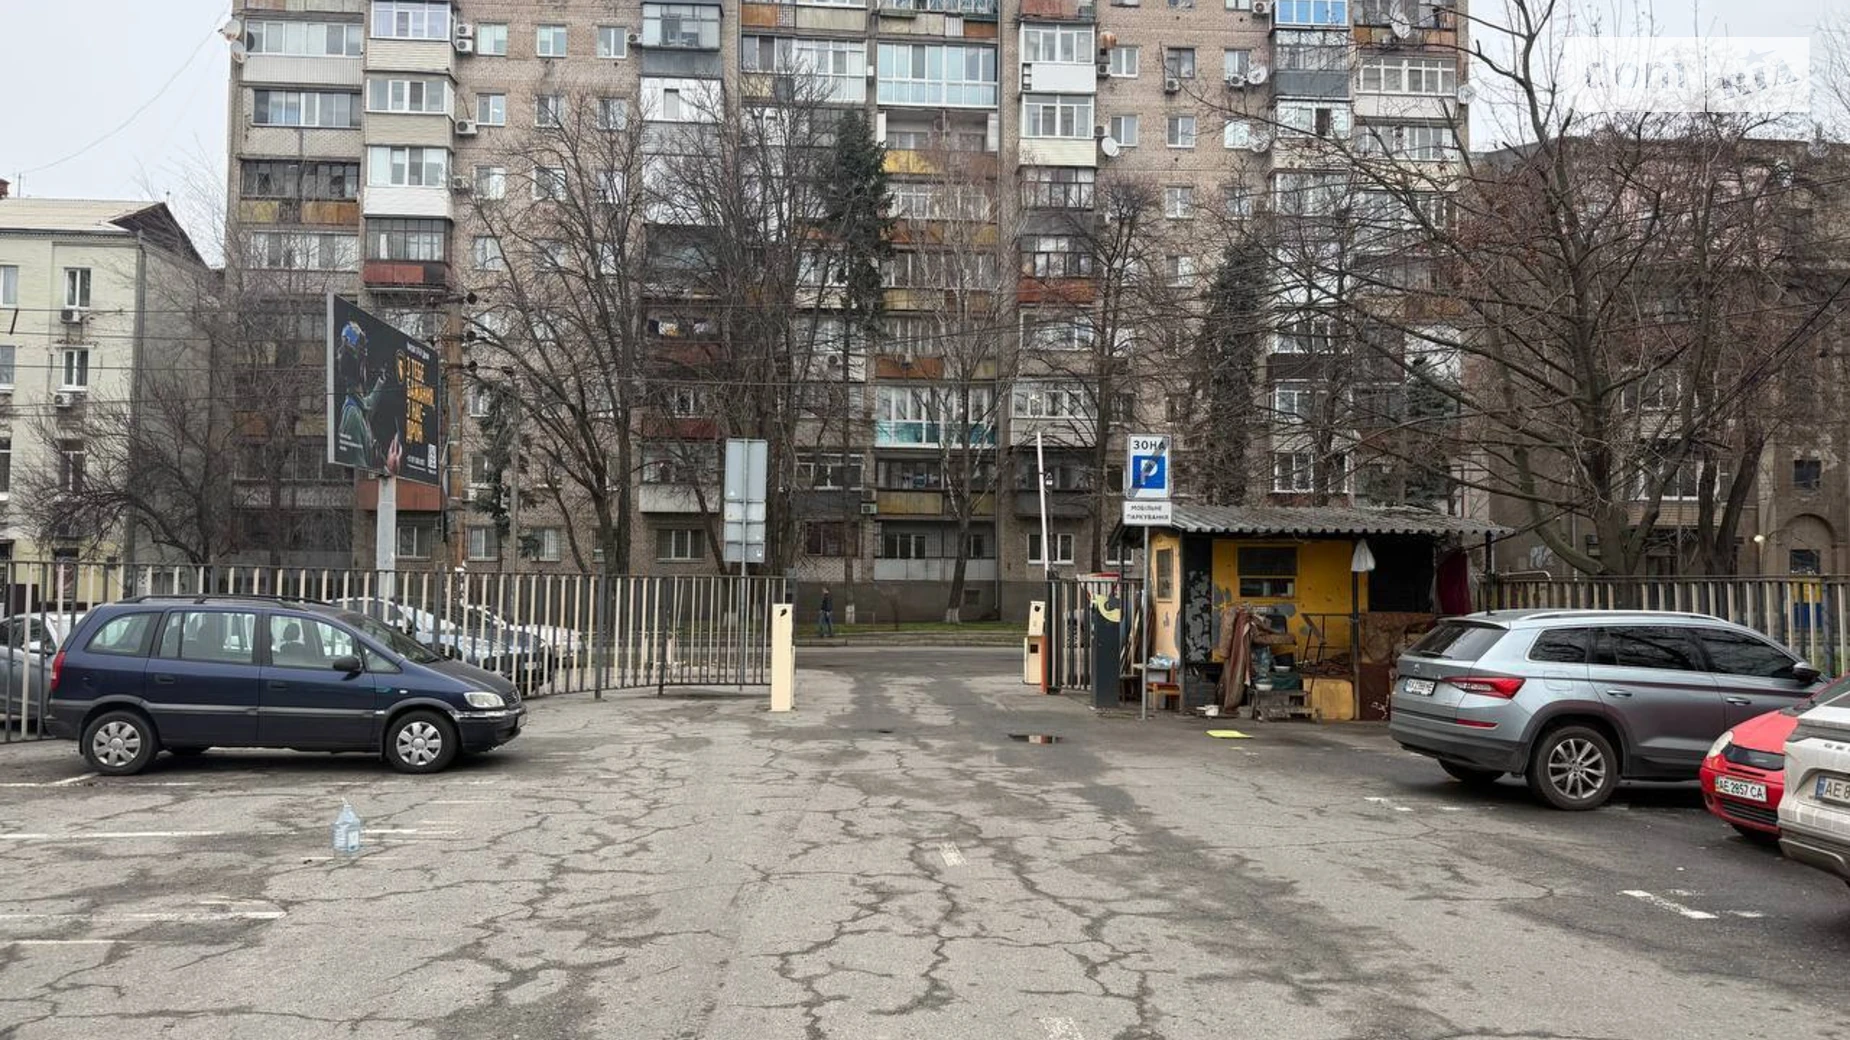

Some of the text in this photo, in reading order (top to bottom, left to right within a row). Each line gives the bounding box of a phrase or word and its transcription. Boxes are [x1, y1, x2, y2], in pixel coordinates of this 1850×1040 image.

[1133, 440, 1166, 450] ЗОНА
[1750, 785, 1764, 799] CA
[1825, 780, 1843, 798] AE
